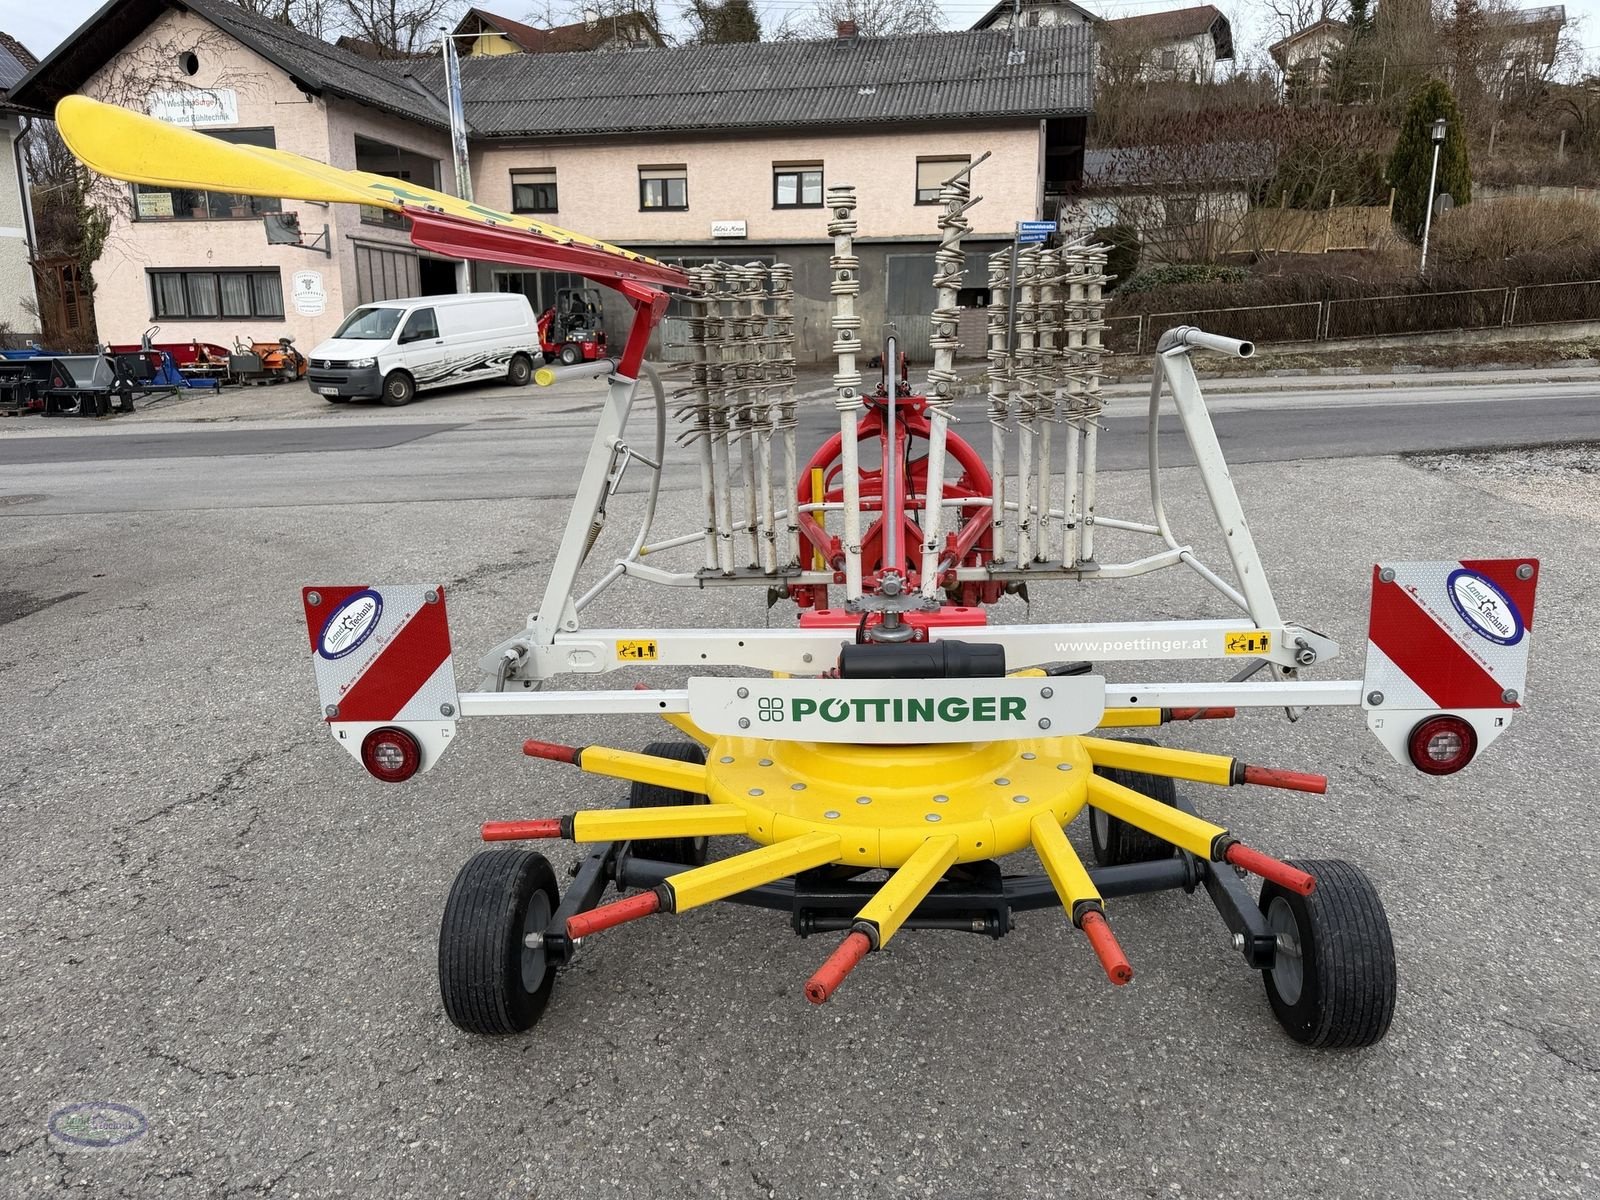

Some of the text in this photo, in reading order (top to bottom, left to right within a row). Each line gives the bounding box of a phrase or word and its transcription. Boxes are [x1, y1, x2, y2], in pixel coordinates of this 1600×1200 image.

[177, 115, 190, 123] und
[1465, 581, 1488, 602] Land
[1482, 606, 1510, 636] Technik
[327, 625, 345, 644] Land
[348, 603, 374, 627] Technik
[1054, 637, 1209, 654] www.poettinger.at
[791, 696, 1028, 723] PÖTTINGER
